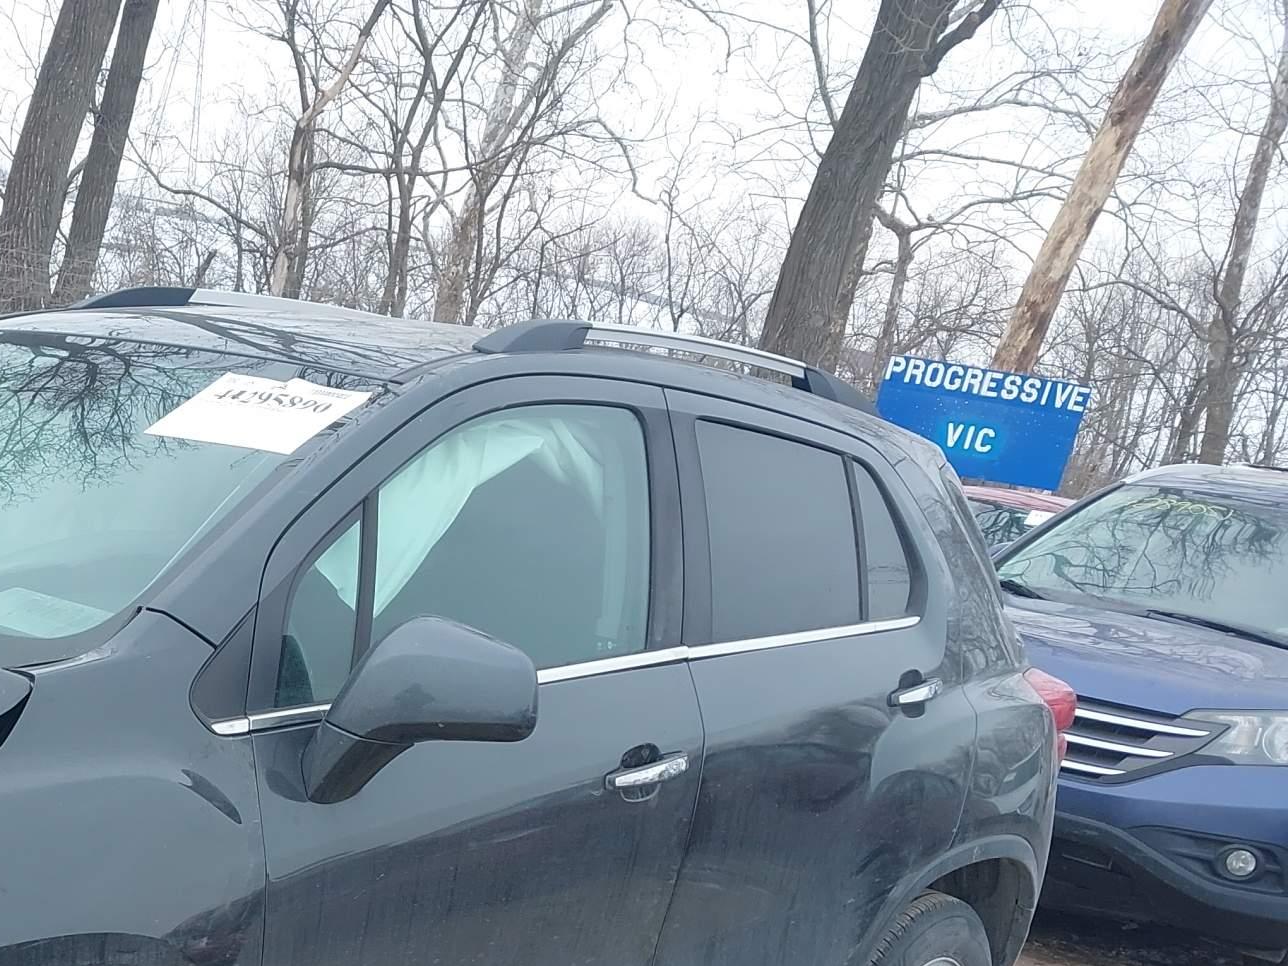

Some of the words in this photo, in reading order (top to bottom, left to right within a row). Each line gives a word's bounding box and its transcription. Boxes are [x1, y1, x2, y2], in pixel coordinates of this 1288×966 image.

[885, 355, 1091, 413] PROGRESSIVE
[214, 388, 333, 414] 44295890
[946, 422, 996, 453] VIC
